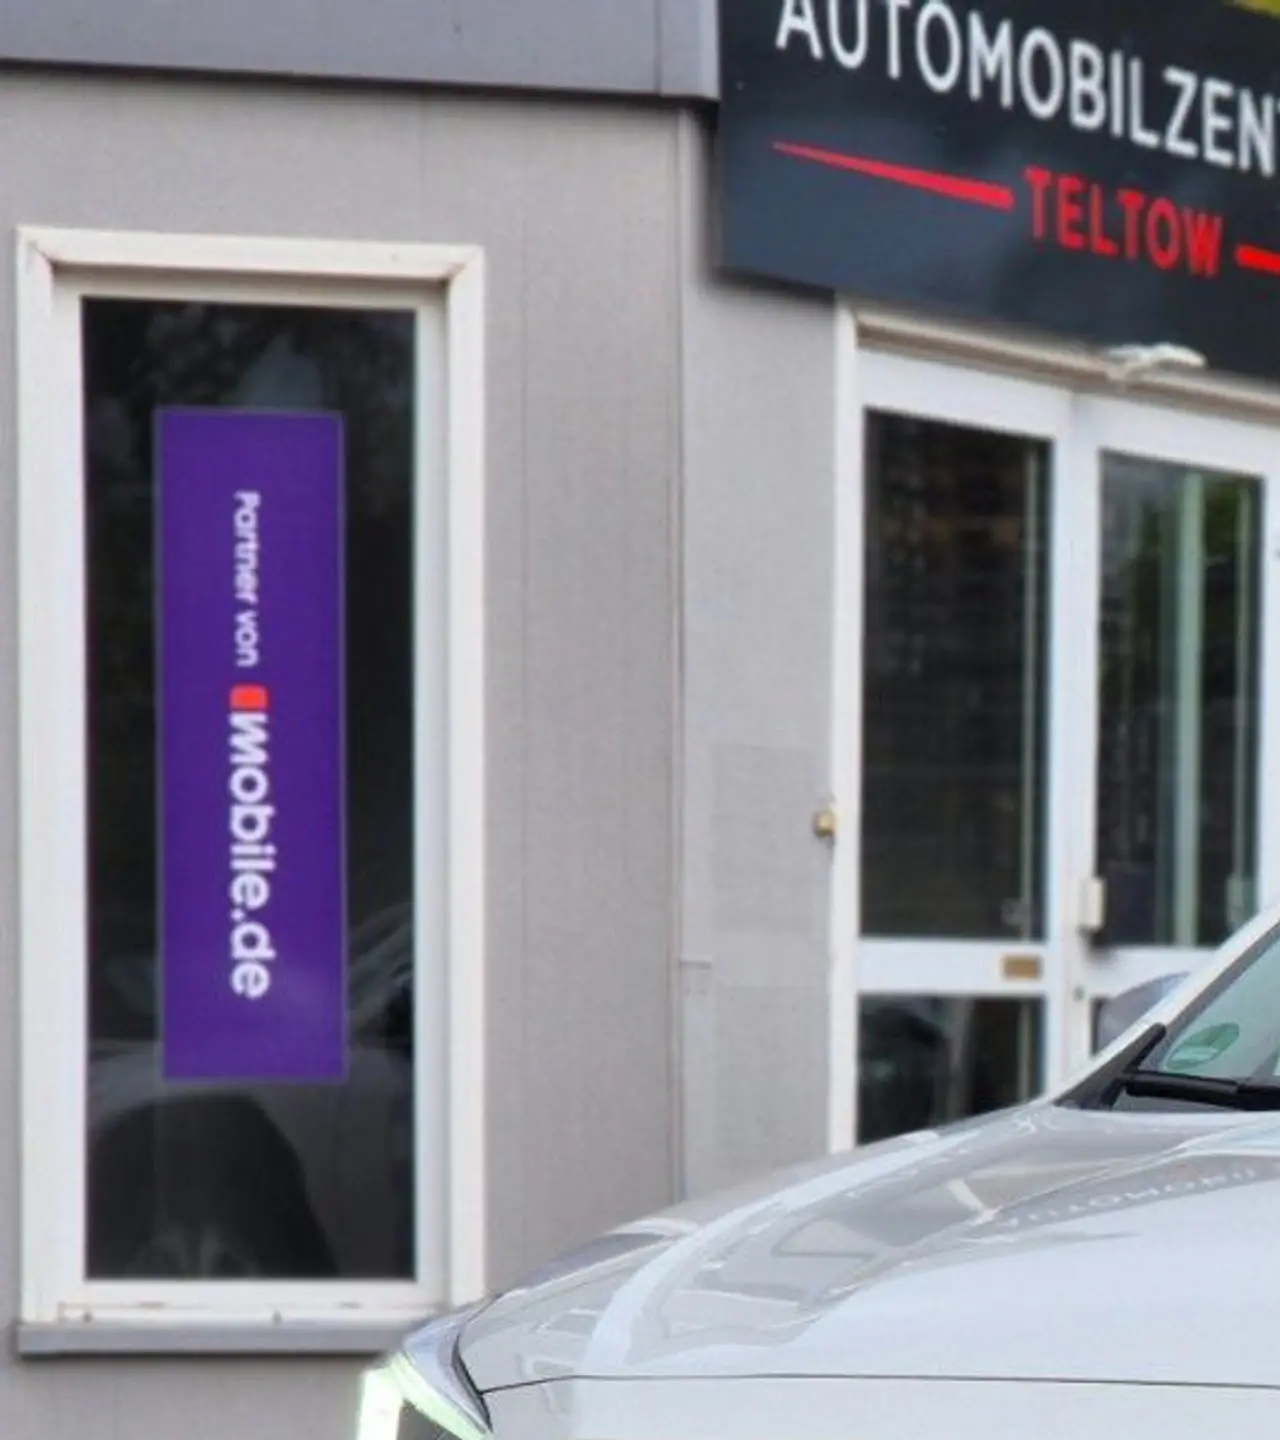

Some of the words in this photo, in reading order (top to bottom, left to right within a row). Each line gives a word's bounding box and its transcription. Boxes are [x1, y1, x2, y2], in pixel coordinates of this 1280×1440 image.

[1024, 166, 1222, 276] TELTOW
[233, 490, 261, 604] Partner
[234, 609, 259, 667] von
